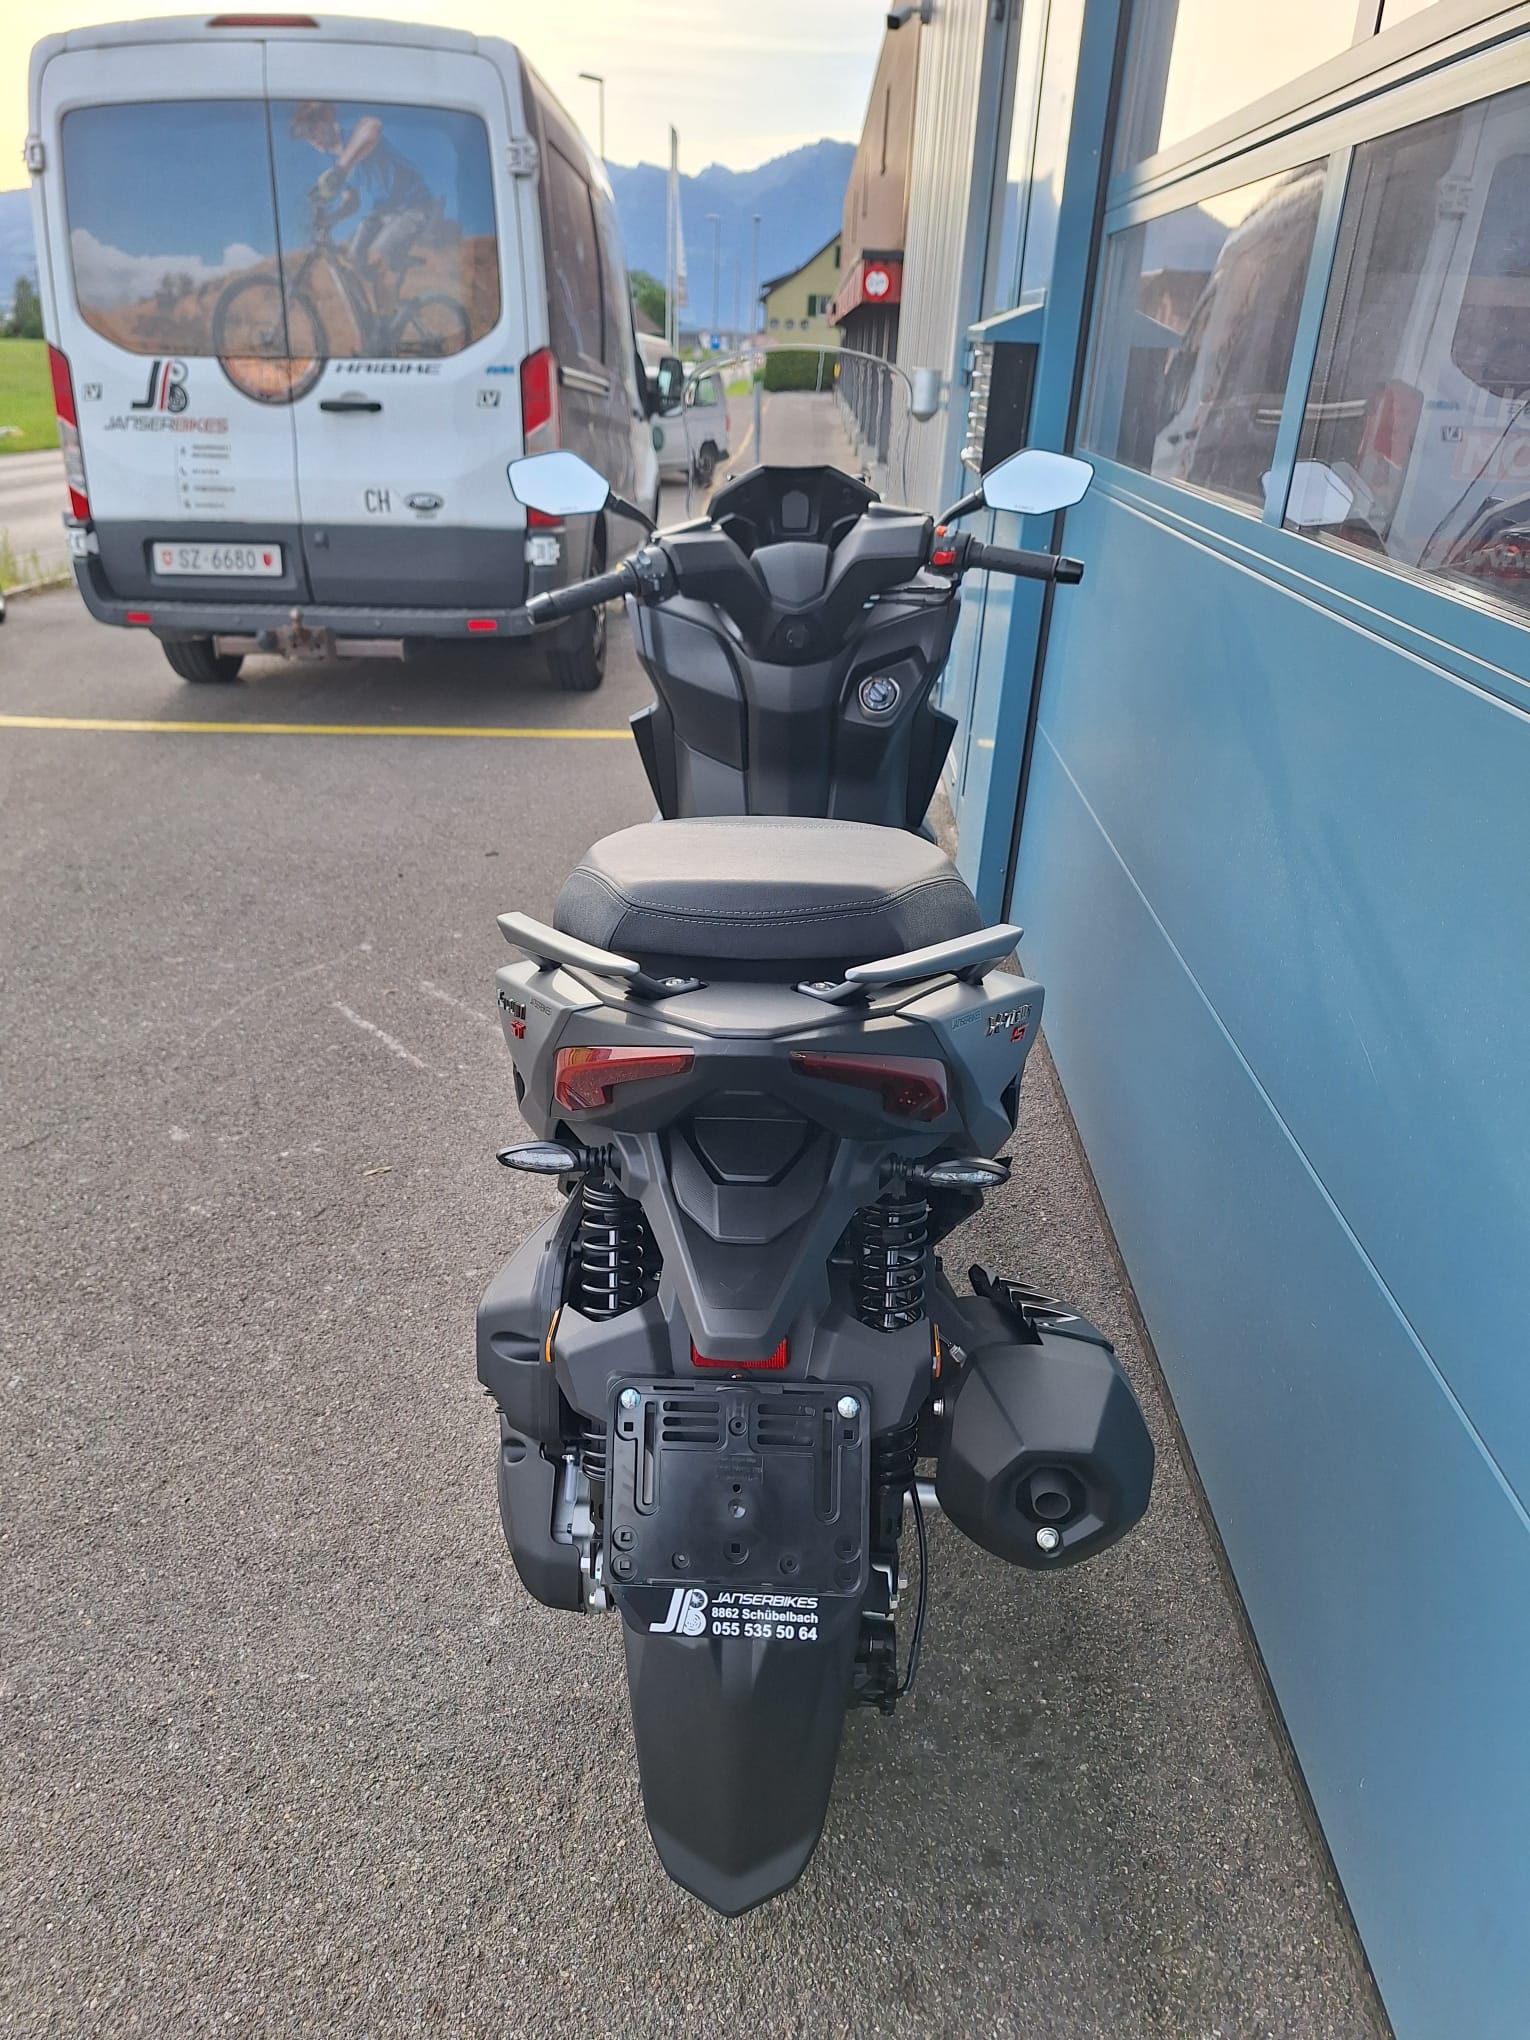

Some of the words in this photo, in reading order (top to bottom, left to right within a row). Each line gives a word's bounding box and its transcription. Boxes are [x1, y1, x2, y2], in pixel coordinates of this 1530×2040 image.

[103, 415, 229, 434] JANSERBIKES
[364, 489, 391, 513] CH
[711, 1592, 819, 1609] JANSERBIKES
[711, 1607, 740, 1619] 8862
[741, 1607, 819, 1624] Schübelbach
[712, 1621, 741, 1636] 055
[743, 1624, 773, 1638] 535
[775, 1625, 796, 1640] 50
[798, 1627, 818, 1641] 64
